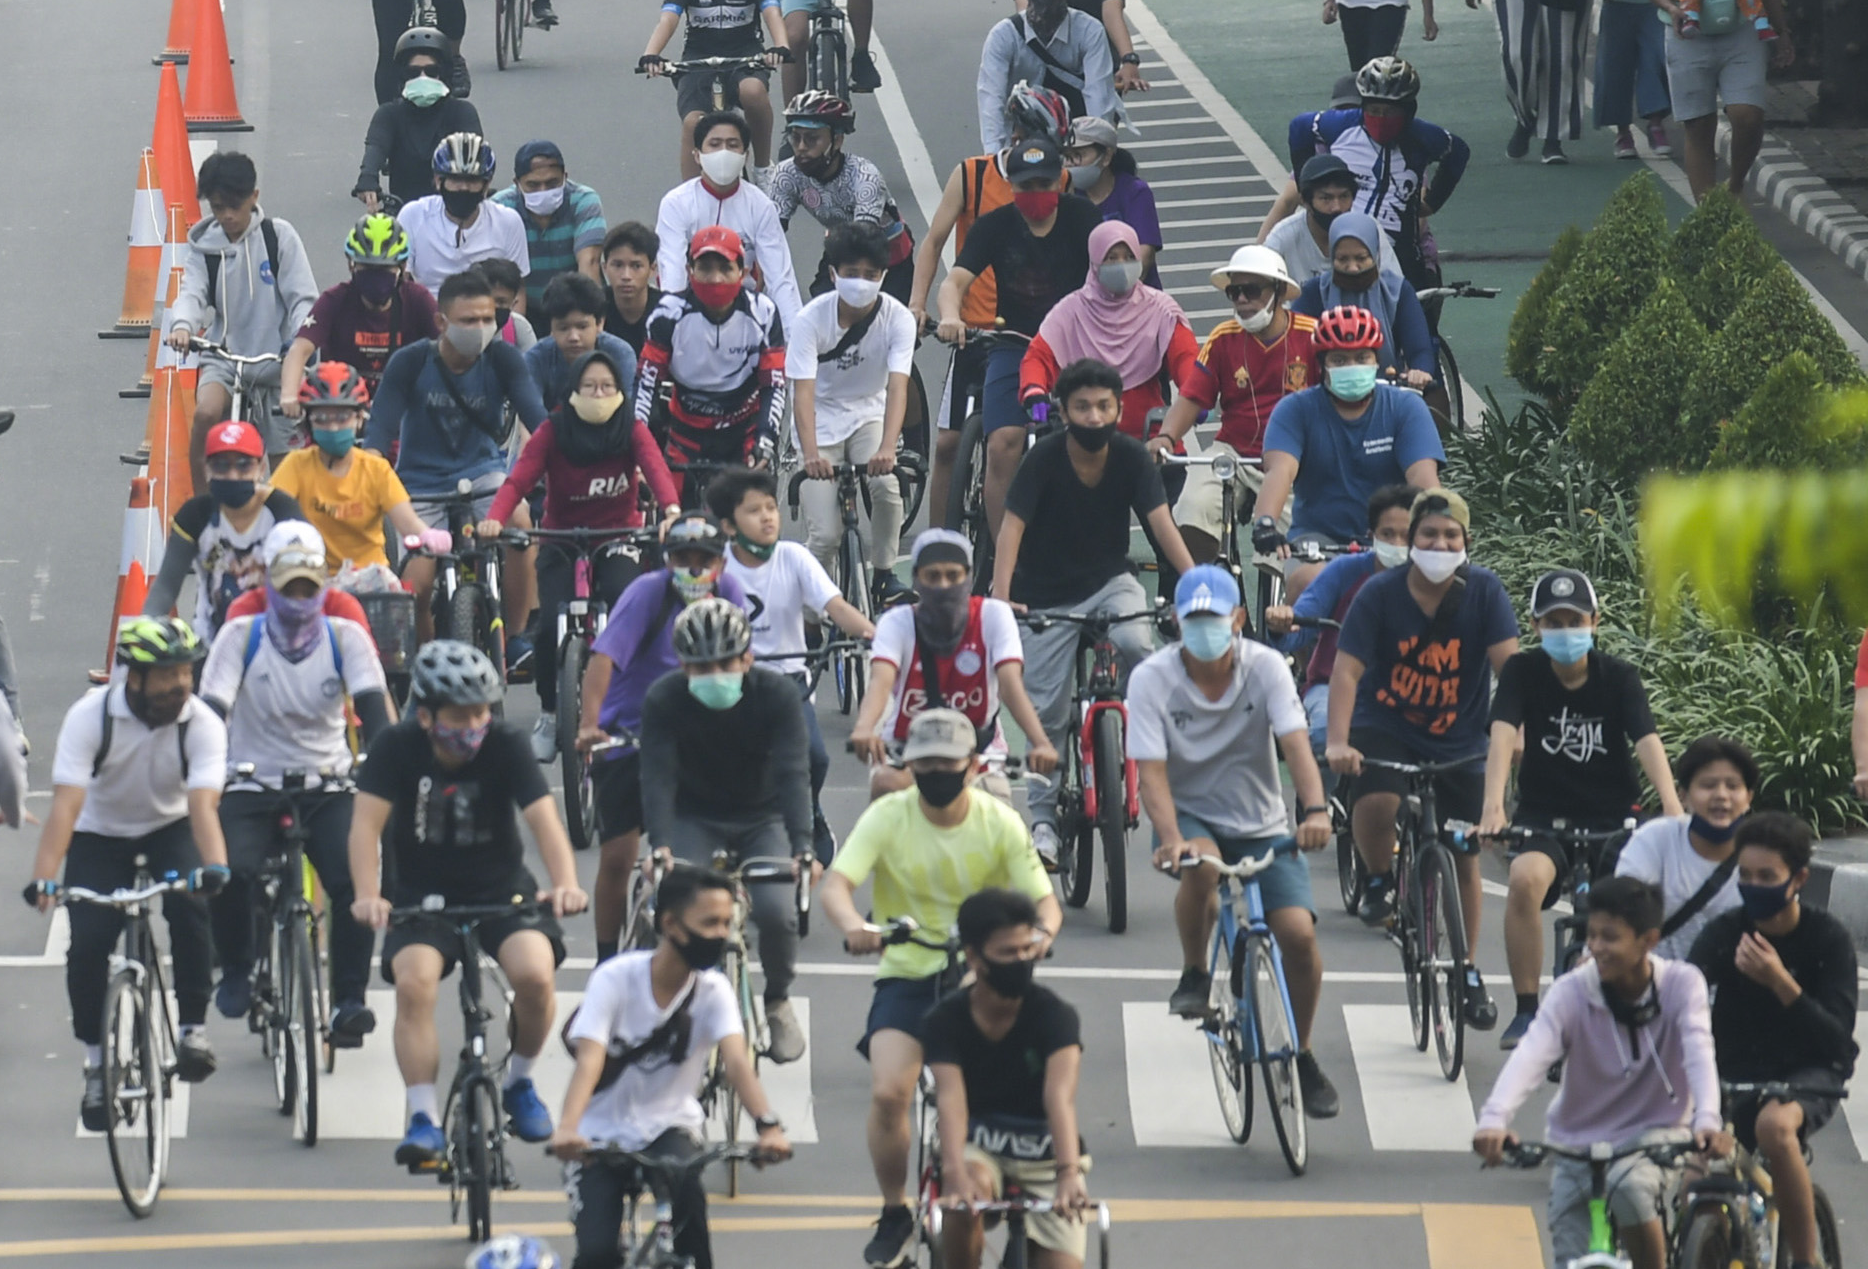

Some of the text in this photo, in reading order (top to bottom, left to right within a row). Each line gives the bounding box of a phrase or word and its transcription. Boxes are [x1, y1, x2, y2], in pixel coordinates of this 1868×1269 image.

[693, 14, 747, 25] GARMIN
[588, 472, 630, 497] RIA
[1390, 662, 1461, 708] WITH
